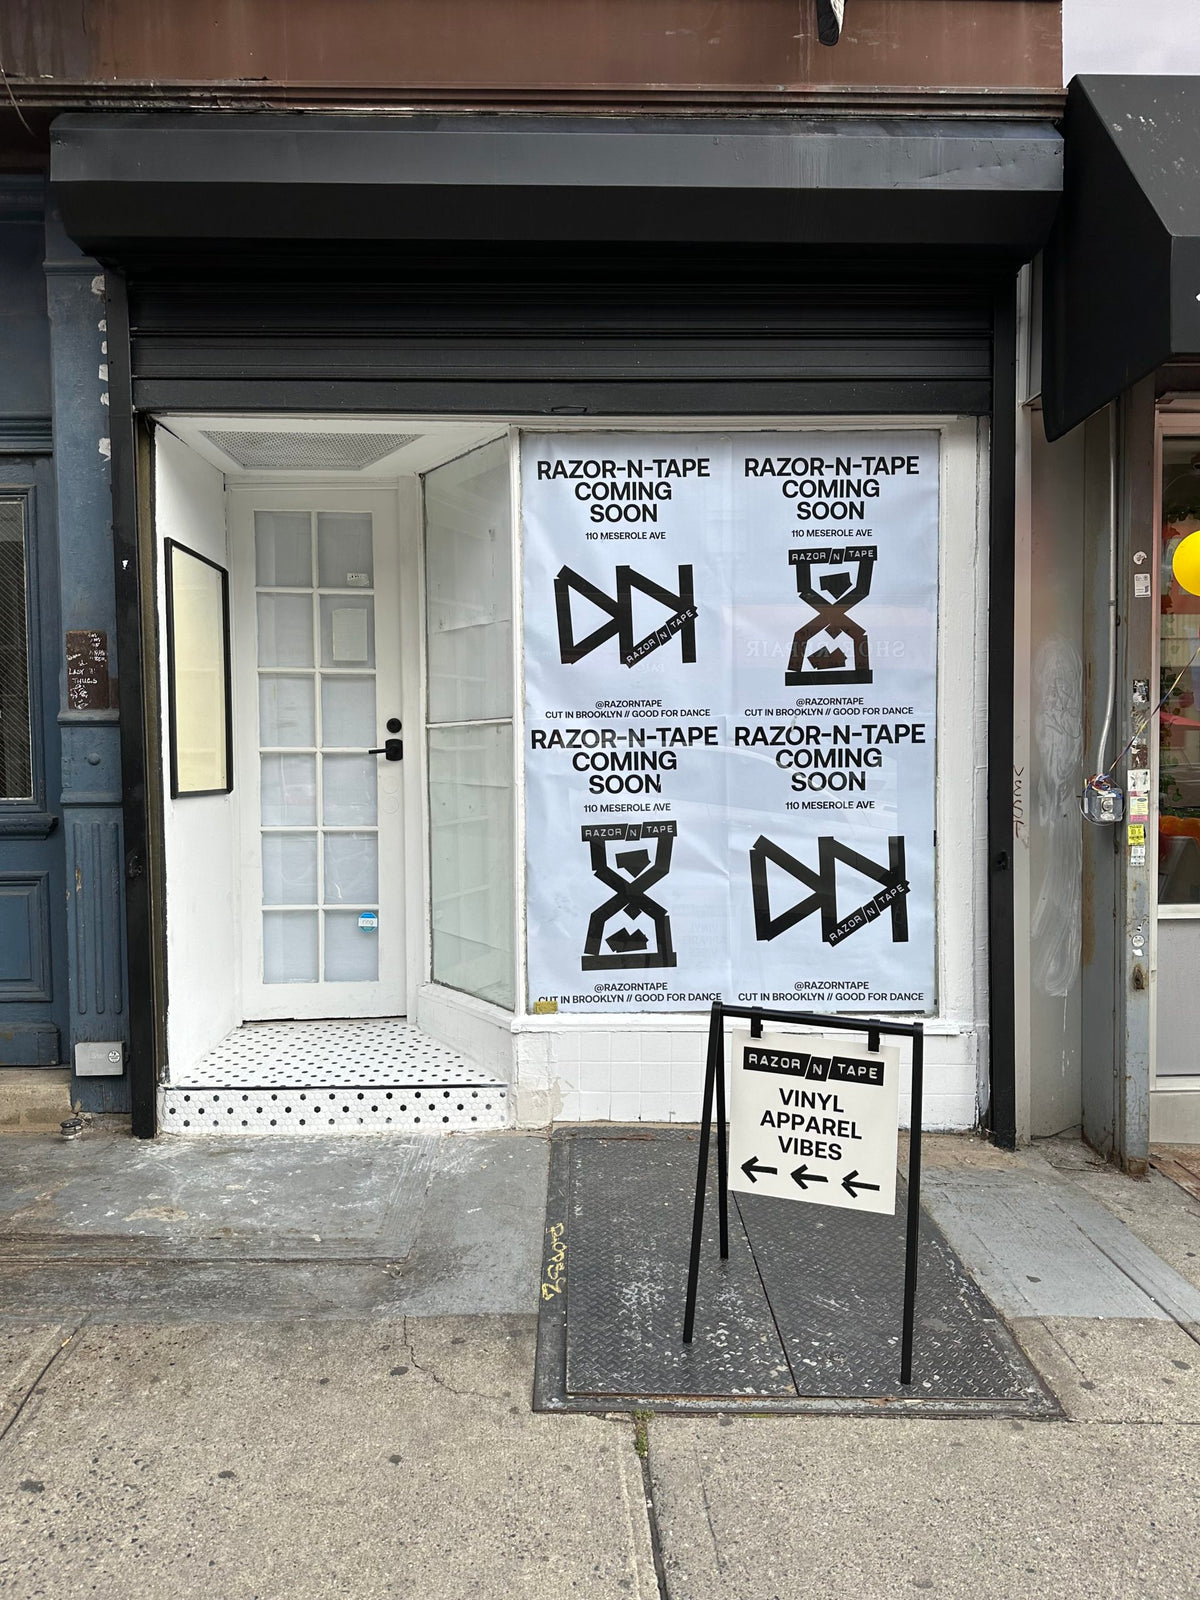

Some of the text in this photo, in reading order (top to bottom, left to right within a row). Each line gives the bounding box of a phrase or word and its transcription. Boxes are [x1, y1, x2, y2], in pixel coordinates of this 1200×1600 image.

[537, 458, 711, 480] RAZOR-N-TAPE
[744, 456, 920, 477] RAZOR-N-TAPE
[574, 481, 672, 501] COMING
[782, 479, 880, 499] COMING
[590, 503, 658, 523] SOON
[796, 501, 865, 521] SOON
[585, 531, 667, 540] 110 MESEROLE AVE
[792, 528, 873, 538] 110 MESEROLE AVE
[791, 552, 826, 561] RAZOR
[849, 549, 874, 558] TAPE
[626, 609, 693, 663] RAZOR N TAPE
[595, 700, 662, 709] @RAZORNTAPE
[745, 709, 763, 717] CUT
[776, 708, 823, 716] BROOKLYN
[833, 707, 860, 716] GOOD
[862, 707, 880, 715] FOR
[884, 706, 914, 715] DANCE
[796, 697, 864, 707] @RAZORNTAPE
[545, 711, 563, 719] CUT
[565, 711, 574, 719] IN
[576, 710, 622, 719] BROOKLYN
[632, 710, 659, 718] GOOD
[661, 709, 678, 717] FOR
[680, 709, 711, 717] DANCE
[531, 726, 719, 749] RAZOR-N-TAPE
[735, 724, 926, 747] RAZOR-N-TAPE
[572, 751, 677, 772] COMING
[776, 748, 883, 769] COMING
[588, 774, 662, 794] SOON
[790, 771, 866, 792] SOON
[584, 803, 671, 813] 110 MESEROLE AVE
[785, 801, 875, 810] 110 MESEROLE AVE
[585, 825, 673, 837] RAZOR N TAPE
[829, 884, 905, 941] RAZOR N TAPE
[594, 983, 668, 993] @RAZORNTAPE
[738, 993, 758, 1001] CUT
[760, 993, 770, 1001] IN
[772, 992, 825, 1001] BROOKLYN
[835, 992, 866, 1001] GOOD
[868, 992, 888, 1001] FOR
[890, 992, 924, 1001] DANCE
[794, 981, 870, 992] @RAZORNTAPE
[560, 996, 570, 1004] IN
[572, 994, 624, 1004] BROOKLYN
[634, 993, 665, 1002] GOOD
[667, 993, 686, 1002] FOR
[688, 992, 722, 1001] DANCE
[748, 1053, 878, 1080] RAZOR N TAPE
[779, 1087, 845, 1113] VINYL
[760, 1109, 862, 1140] APPAREL
[778, 1135, 842, 1161] VIBES
